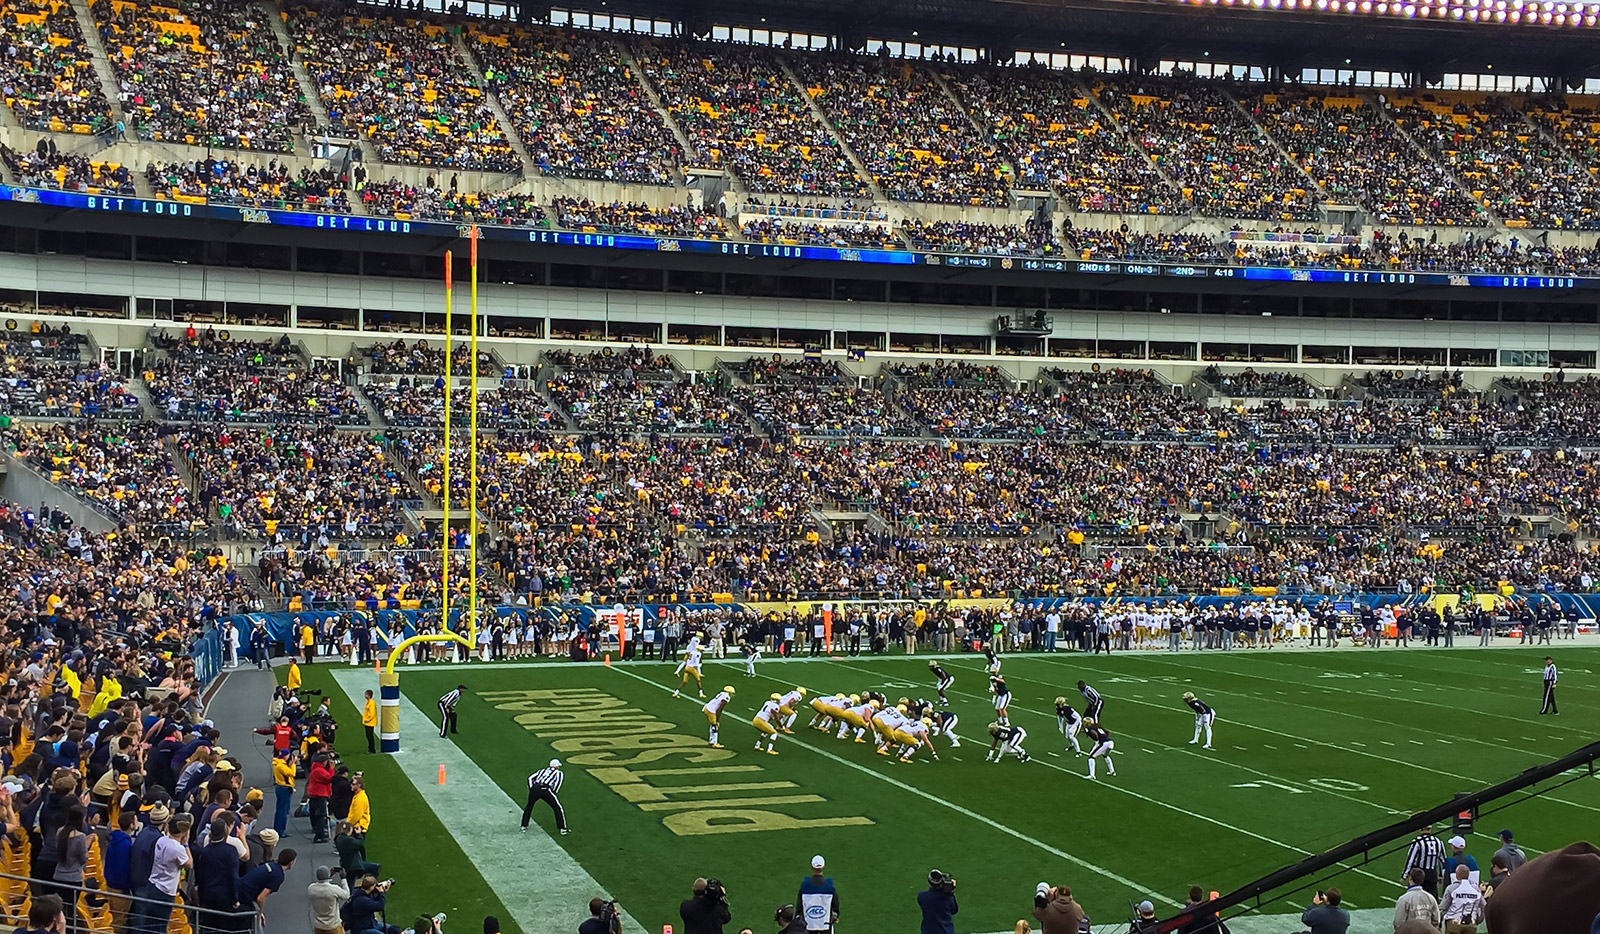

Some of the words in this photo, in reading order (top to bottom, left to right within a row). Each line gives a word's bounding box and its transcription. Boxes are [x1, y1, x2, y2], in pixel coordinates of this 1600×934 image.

[87, 196, 124, 211] GET
[142, 201, 192, 216] LOUD
[316, 215, 350, 229] GET
[365, 219, 411, 233] LOUD
[529, 231, 560, 243] GET
[573, 234, 615, 247] LOUD
[721, 243, 750, 255] GET
[763, 246, 801, 257] LOUD
[1025, 260, 1038, 269] 14
[1175, 267, 1195, 276] 2ND
[1343, 272, 1369, 283] GET
[1380, 273, 1415, 284] LOUD
[1503, 277, 1528, 287] GET
[1539, 278, 1574, 288] LOUD
[475, 687, 877, 837] PITTSBURGH
[1426, 840, 1437, 856] H
